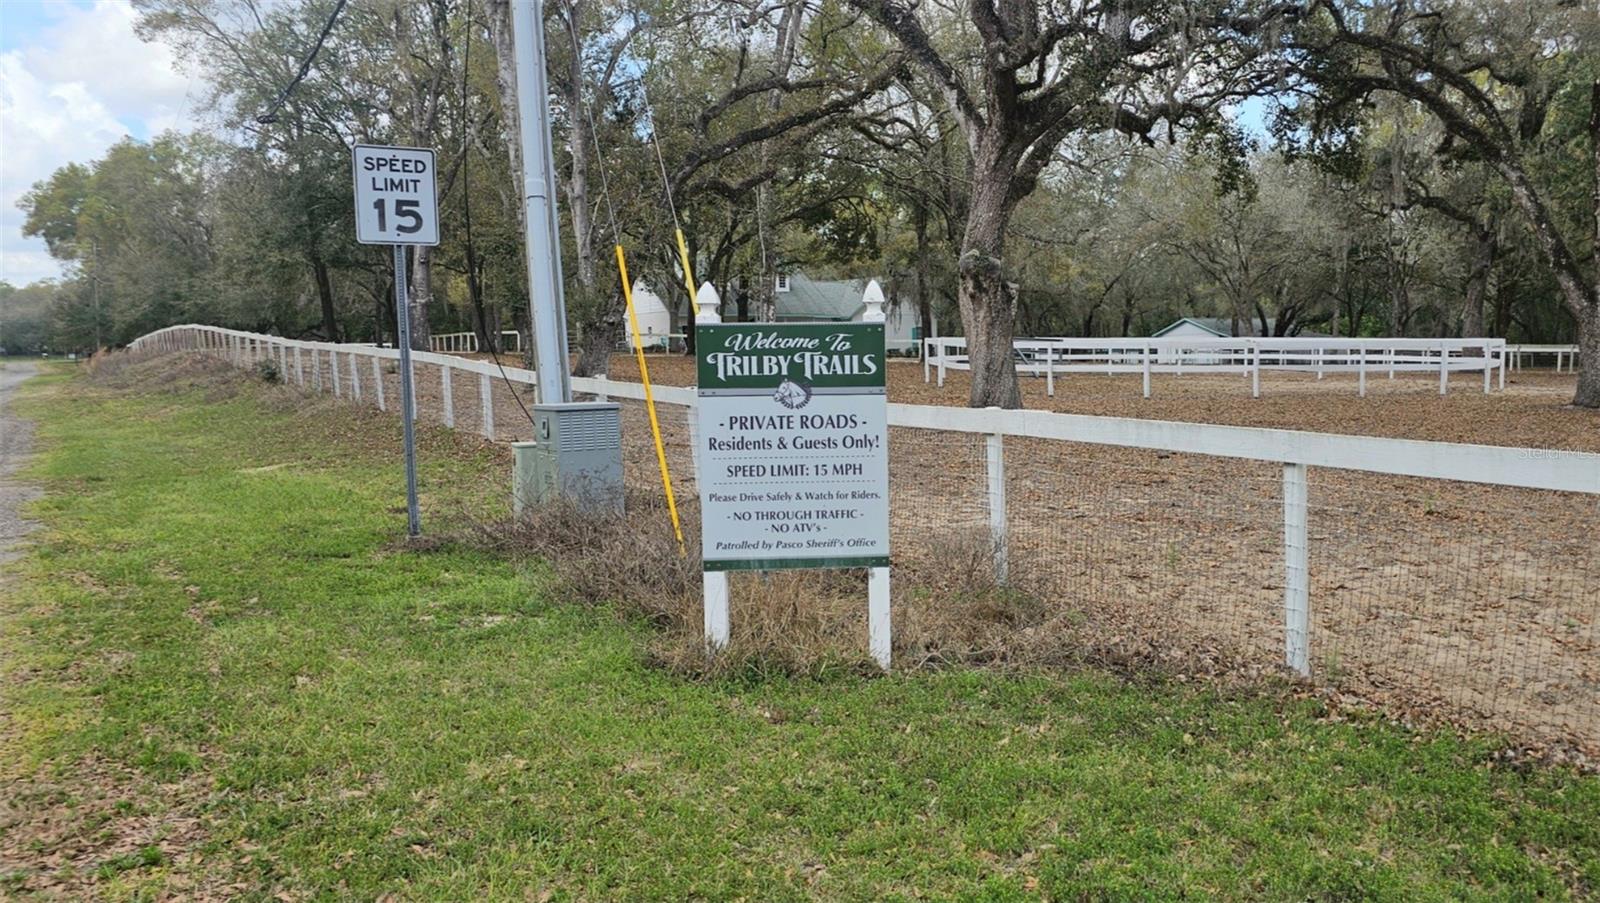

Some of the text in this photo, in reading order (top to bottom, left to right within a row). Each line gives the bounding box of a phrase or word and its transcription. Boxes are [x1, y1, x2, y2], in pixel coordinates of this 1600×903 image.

[364, 157, 426, 173] SPEED
[372, 177, 421, 192] LIMIT
[373, 198, 423, 233] 15
[724, 331, 853, 352] Welcome To
[706, 351, 877, 382] TRILBY TRAILS
[729, 415, 794, 430] PRIVATE
[800, 414, 858, 430] ROADS
[708, 434, 880, 451] Residents & Guests Only!
[727, 463, 862, 478] SPEED LIMIT: 15 MPH
[709, 491, 881, 502] Please Drive Safely & Watch for Riders.
[733, 512, 751, 521] NO
[755, 510, 812, 520] THROUGH
[816, 509, 858, 519] TRAFFIC
[771, 524, 789, 533] NO
[793, 523, 821, 532] ATV's
[716, 538, 876, 551] Patrolled by Pasco Sheriff's Office
